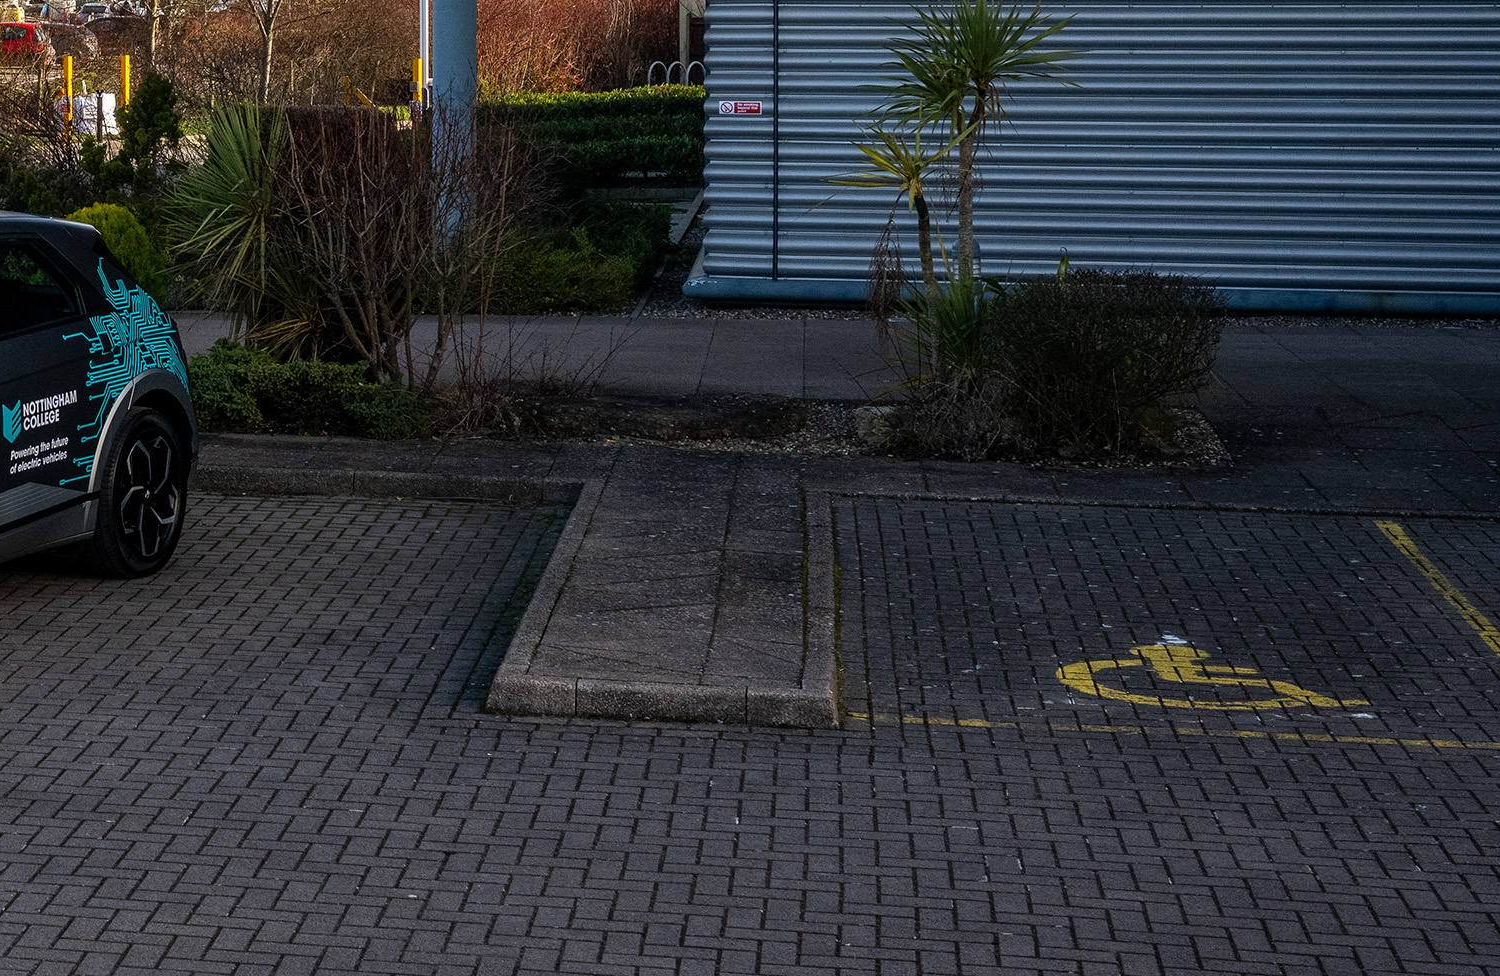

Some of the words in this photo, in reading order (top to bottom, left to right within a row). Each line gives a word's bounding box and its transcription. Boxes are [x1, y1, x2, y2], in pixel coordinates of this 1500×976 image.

[22, 390, 78, 417] NOTTINGHAM
[23, 409, 60, 431] COLLEGE
[10, 445, 40, 461] Powering
[40, 441, 51, 452] the
[51, 436, 69, 449] future
[9, 463, 17, 475] of
[17, 457, 42, 473] electric
[43, 450, 68, 465] vehicles
